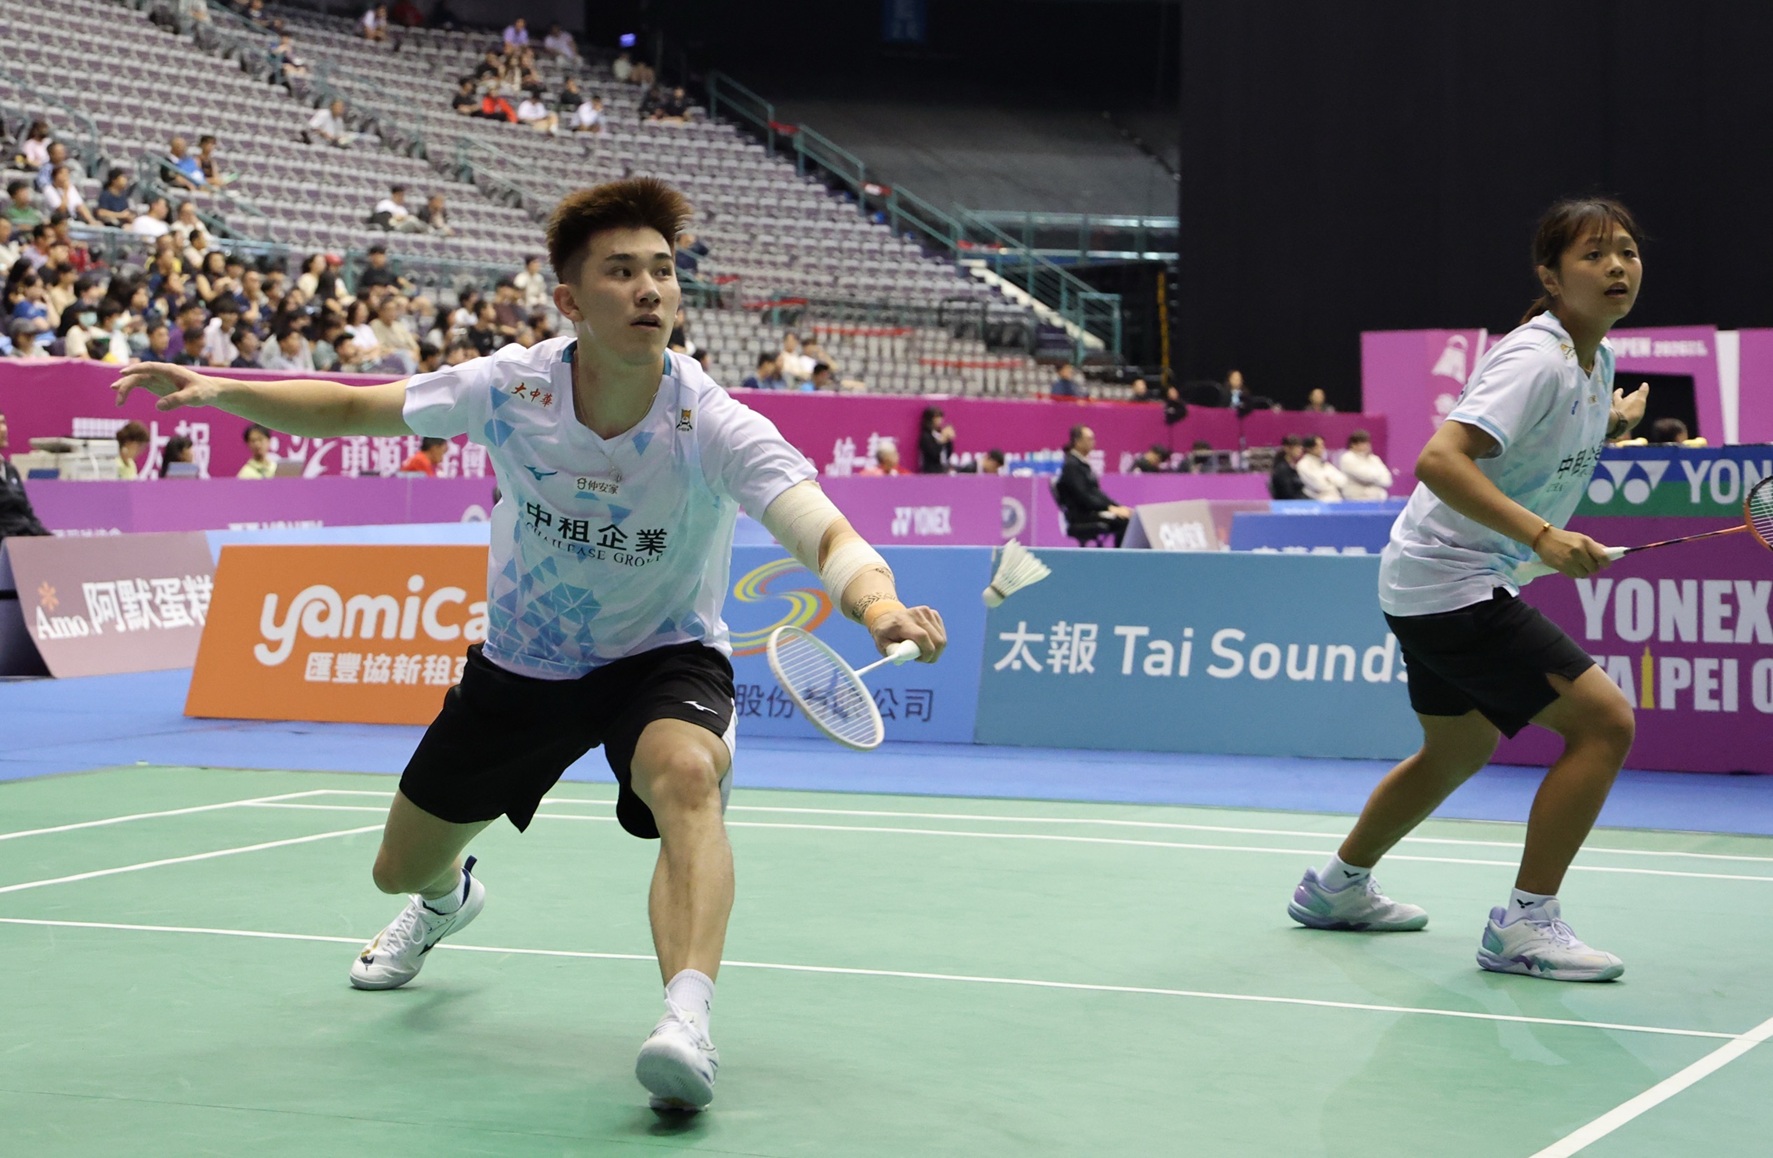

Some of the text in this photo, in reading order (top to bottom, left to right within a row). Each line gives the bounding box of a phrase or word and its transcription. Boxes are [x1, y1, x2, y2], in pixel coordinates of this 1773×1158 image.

[511, 382, 553, 407] 大中華
[526, 502, 667, 556] 中租企業
[82, 574, 214, 635] 阿默蛋糕
[1575, 577, 1773, 645] YONEX
[994, 620, 1099, 675] 太報
[1113, 625, 1194, 677] Tai
[736, 684, 935, 723] 股份公司
